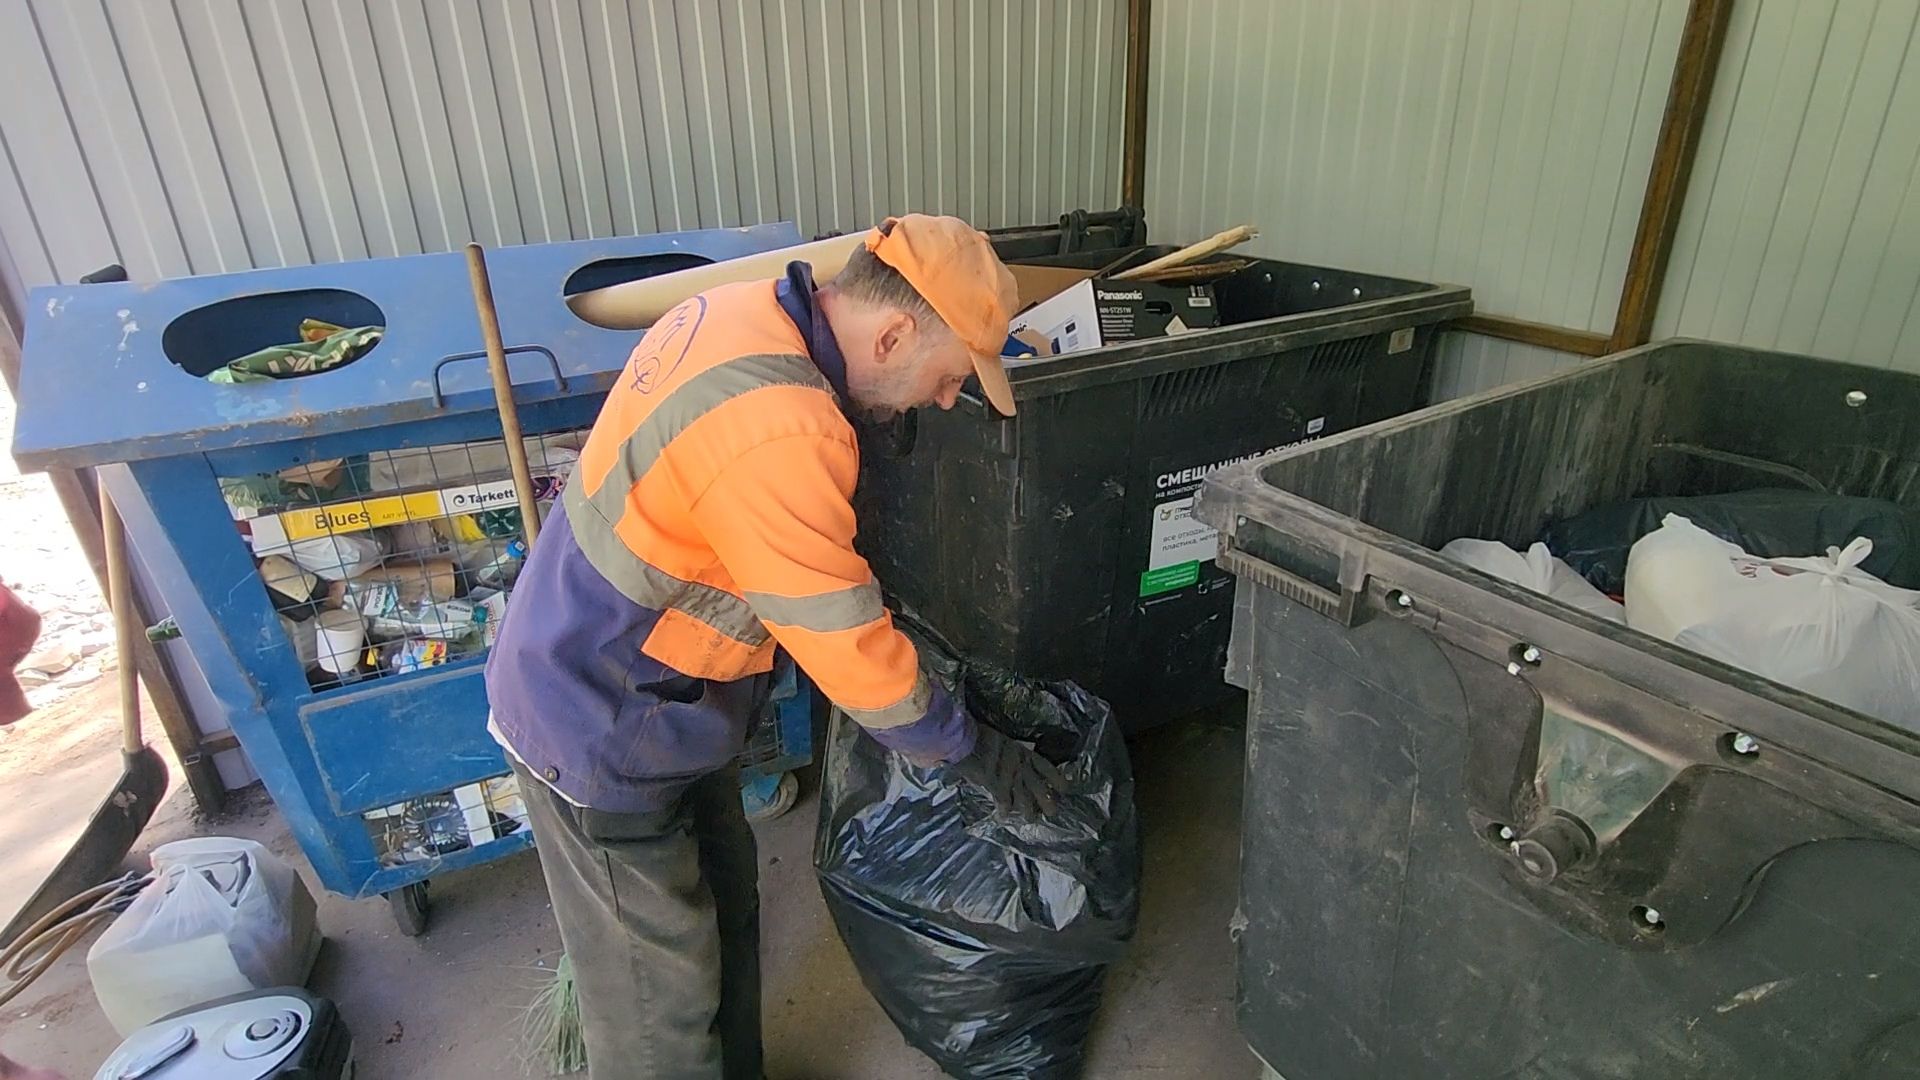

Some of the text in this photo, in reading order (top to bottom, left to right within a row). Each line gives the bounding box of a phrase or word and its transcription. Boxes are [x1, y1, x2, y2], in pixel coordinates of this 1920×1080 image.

[1097, 290, 1143, 300] Panasonic
[468, 489, 515, 504] Tarkett
[315, 511, 371, 530] Blues
